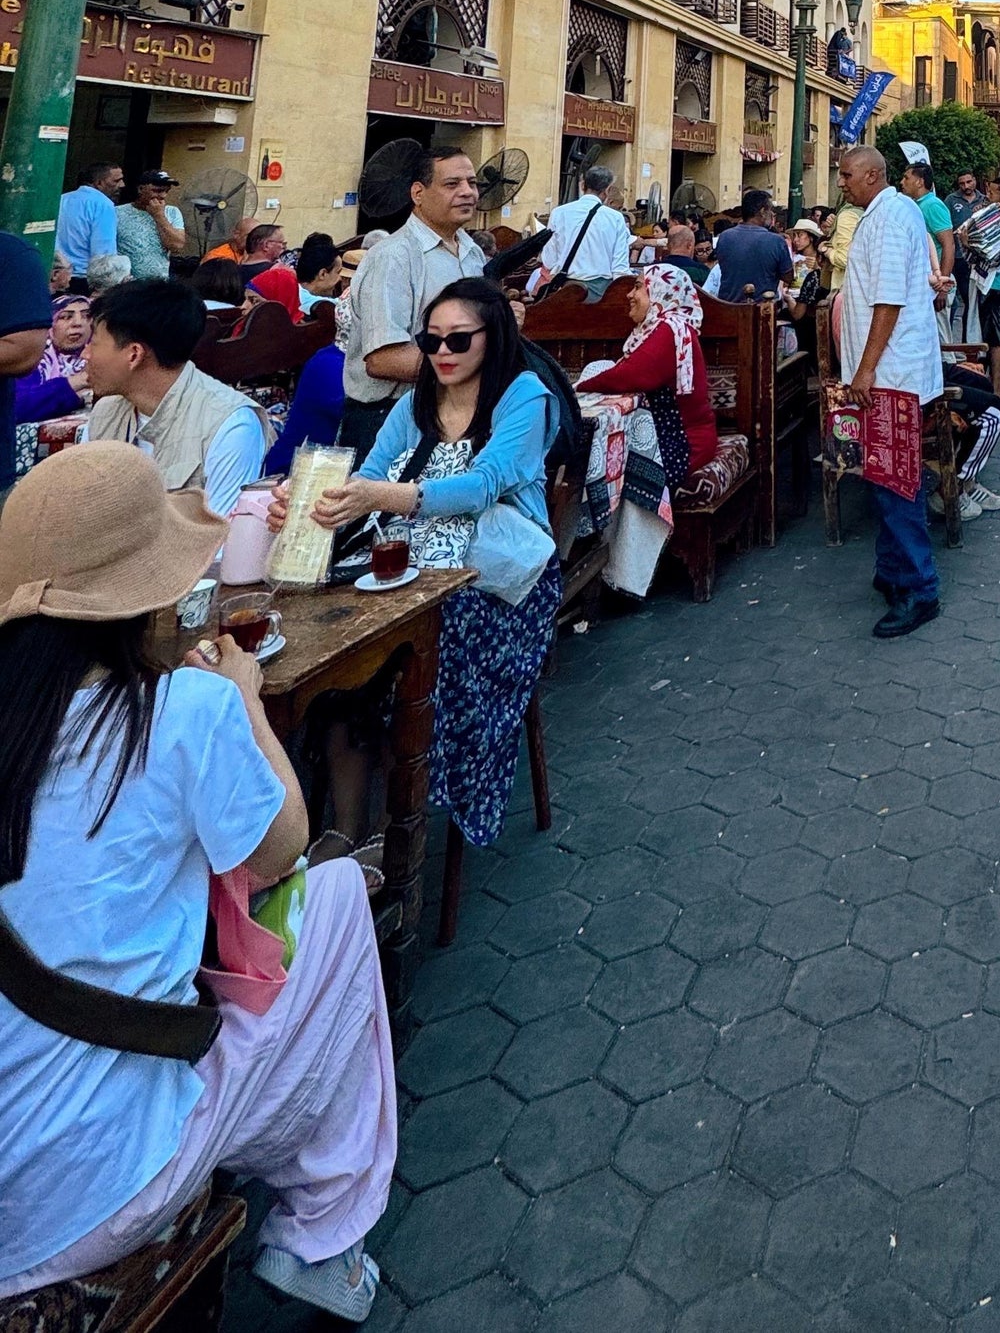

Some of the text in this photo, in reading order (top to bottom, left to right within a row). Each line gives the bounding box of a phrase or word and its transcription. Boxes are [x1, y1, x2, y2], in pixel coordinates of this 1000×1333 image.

[133, 23, 216, 66] قهوة
[124, 61, 248, 96] Restaurant
[395, 71, 447, 111] مازن
[479, 82, 500, 97] Shop
[849, 101, 868, 130] elezaby
